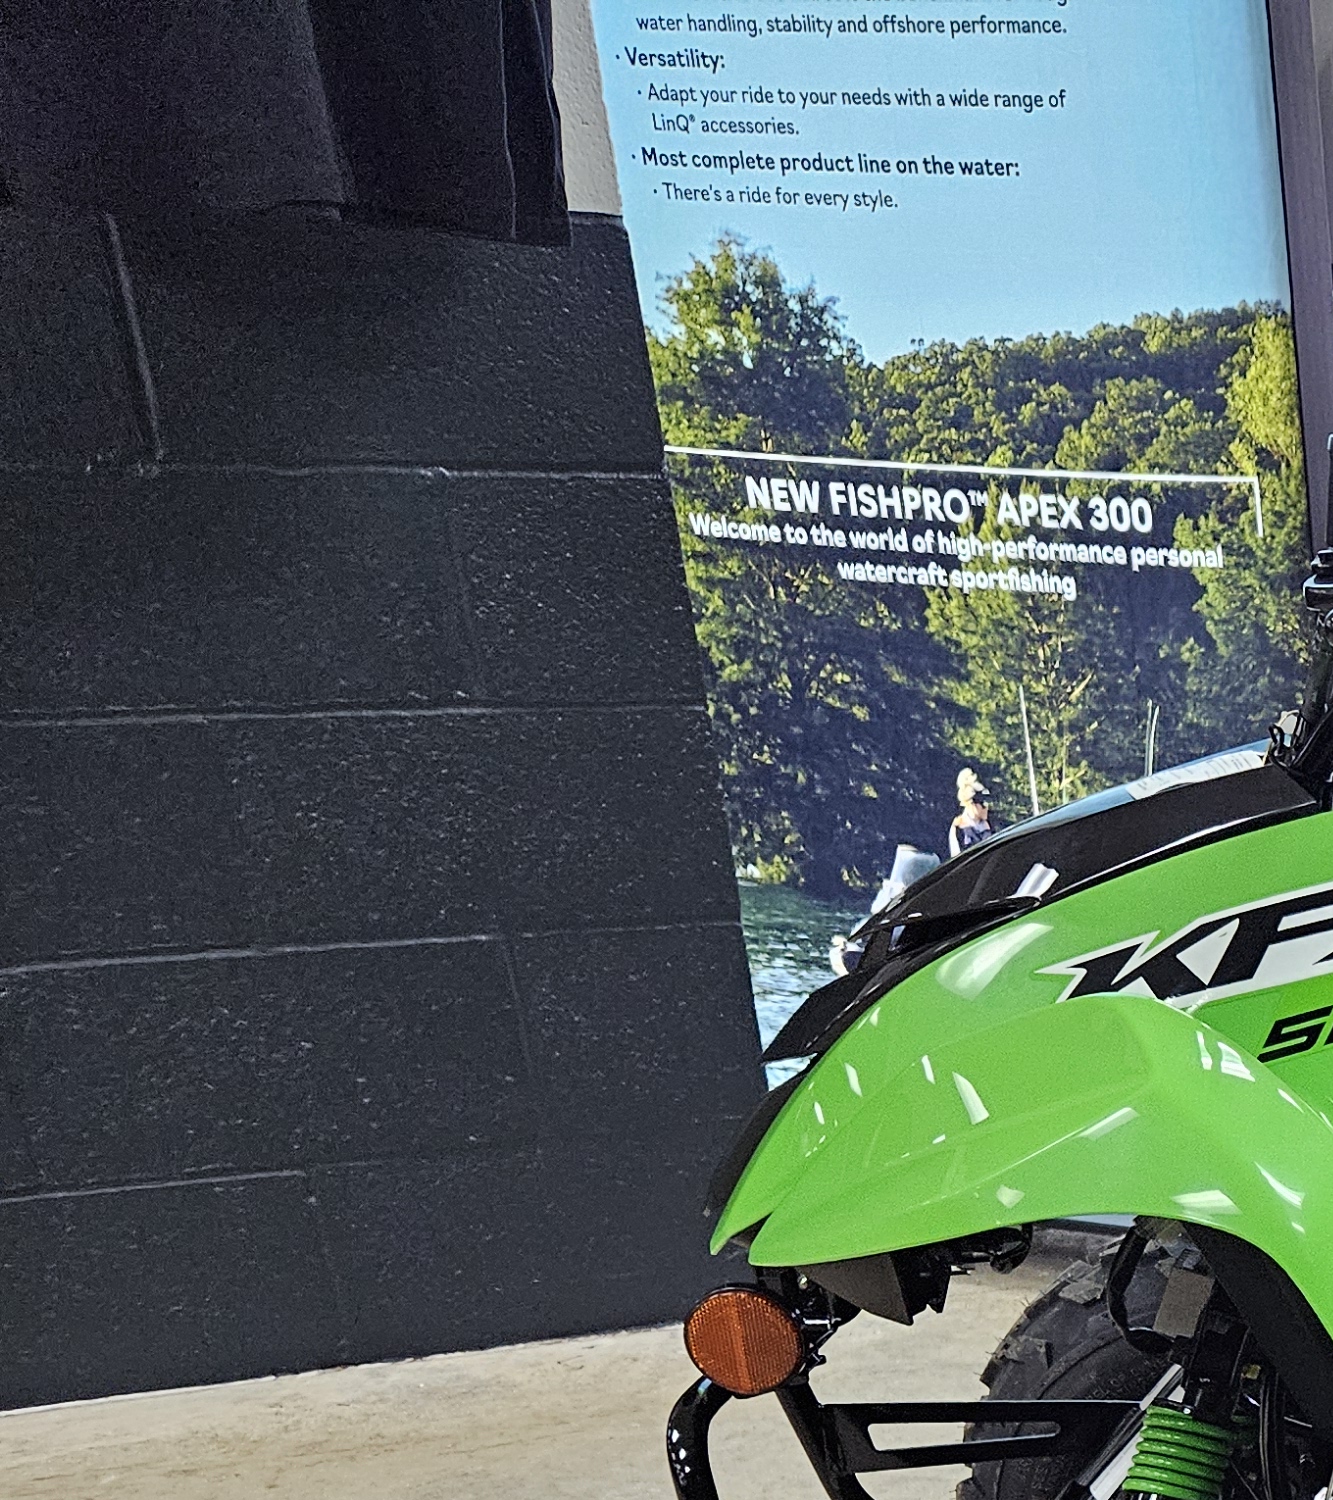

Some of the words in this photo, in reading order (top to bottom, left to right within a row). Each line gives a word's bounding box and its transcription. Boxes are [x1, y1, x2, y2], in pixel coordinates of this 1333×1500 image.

[636, 17, 683, 31] water
[687, 14, 763, 37] handling,
[766, 15, 833, 38] stability
[838, 17, 868, 33] and
[873, 15, 945, 33] offshore
[950, 15, 1067, 39] performance.
[625, 47, 725, 74] Versatility:
[648, 83, 696, 106] Adapt
[700, 89, 737, 107] your
[742, 86, 773, 103] ride
[778, 90, 795, 104] to
[799, 92, 837, 109] your
[842, 87, 891, 105] needs
[895, 88, 931, 106] with
[936, 94, 945, 106] a
[950, 89, 989, 107] wide
[994, 94, 1044, 113] range
[1049, 89, 1066, 107] of
[702, 117, 799, 134] accessories.
[641, 147, 687, 168] Most
[692, 151, 775, 175] complete
[781, 152, 854, 176] product
[858, 154, 890, 173] line
[896, 160, 918, 174] on
[923, 155, 954, 174] the
[959, 159, 1020, 176] water:
[662, 182, 721, 201] There's
[726, 192, 734, 202] a
[739, 186, 770, 203] ride
[776, 187, 800, 204] for
[805, 194, 848, 211] every
[854, 190, 898, 212] style.
[745, 475, 820, 513] NEW
[997, 491, 1084, 530] APEX
[1088, 495, 1152, 533] 300
[689, 512, 781, 542] Welcome
[784, 523, 807, 544] to
[810, 522, 846, 548] the
[850, 527, 908, 552] world
[912, 528, 935, 554] of
[936, 528, 1127, 565] high-performance
[1130, 544, 1223, 572] personal
[837, 561, 949, 587] watercraft
[952, 568, 1076, 600] sportfishing
